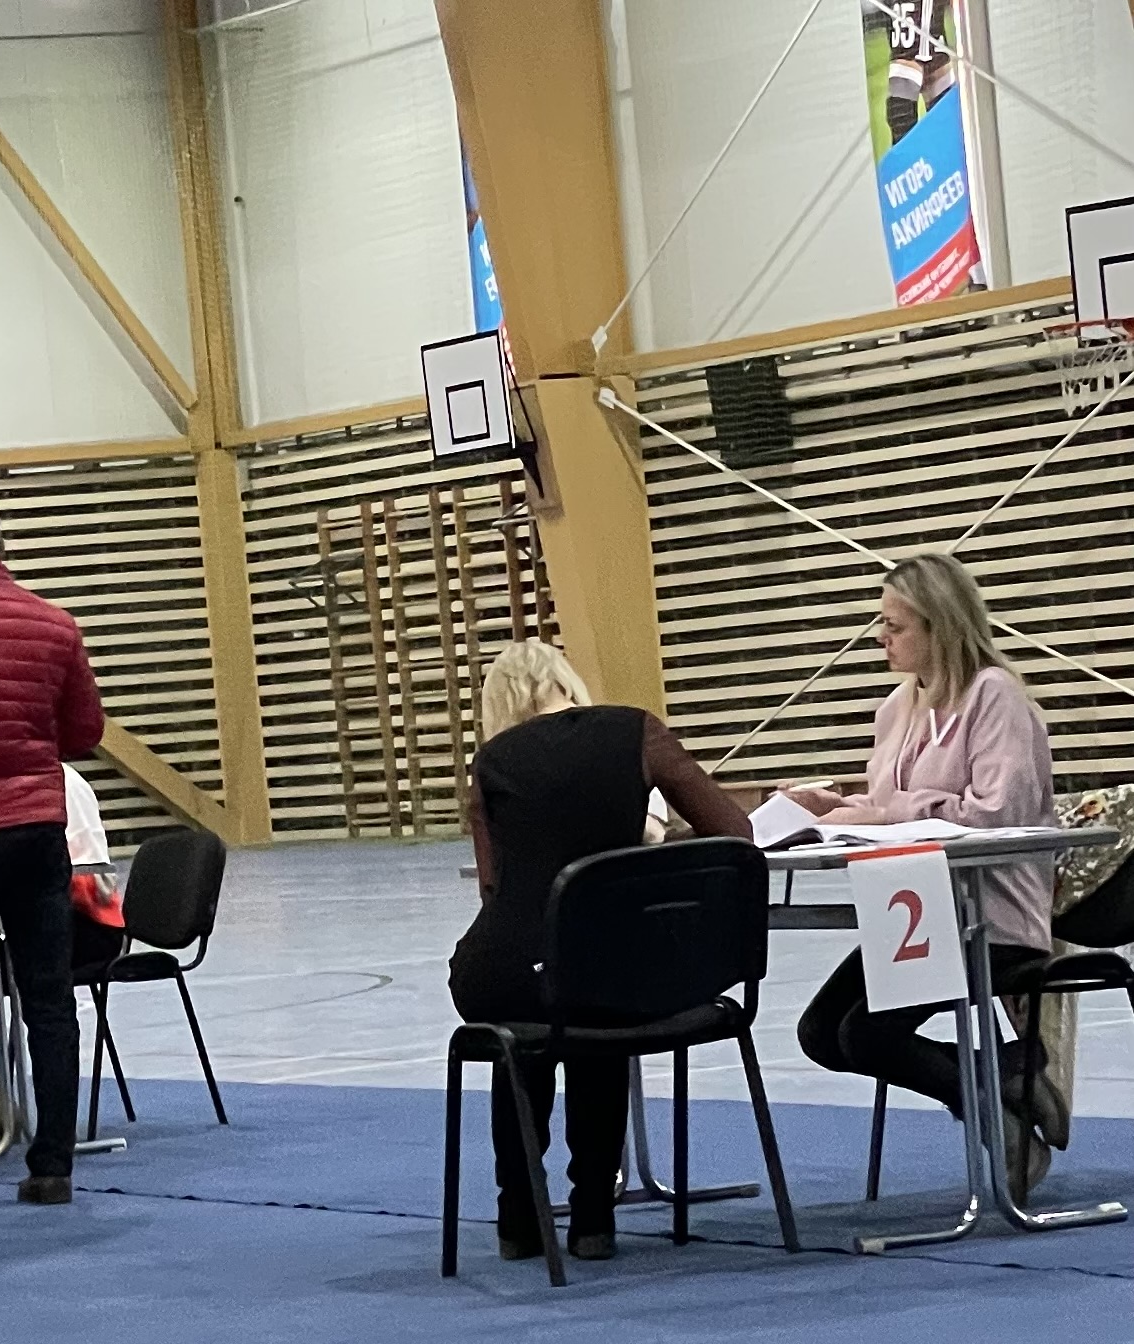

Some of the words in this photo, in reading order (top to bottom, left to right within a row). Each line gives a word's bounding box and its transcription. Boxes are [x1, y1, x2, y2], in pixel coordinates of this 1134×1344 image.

[884, 157, 934, 209] ИГОРЬ
[890, 170, 965, 250] АКИНФЕЕВ
[887, 889, 930, 963] 2
